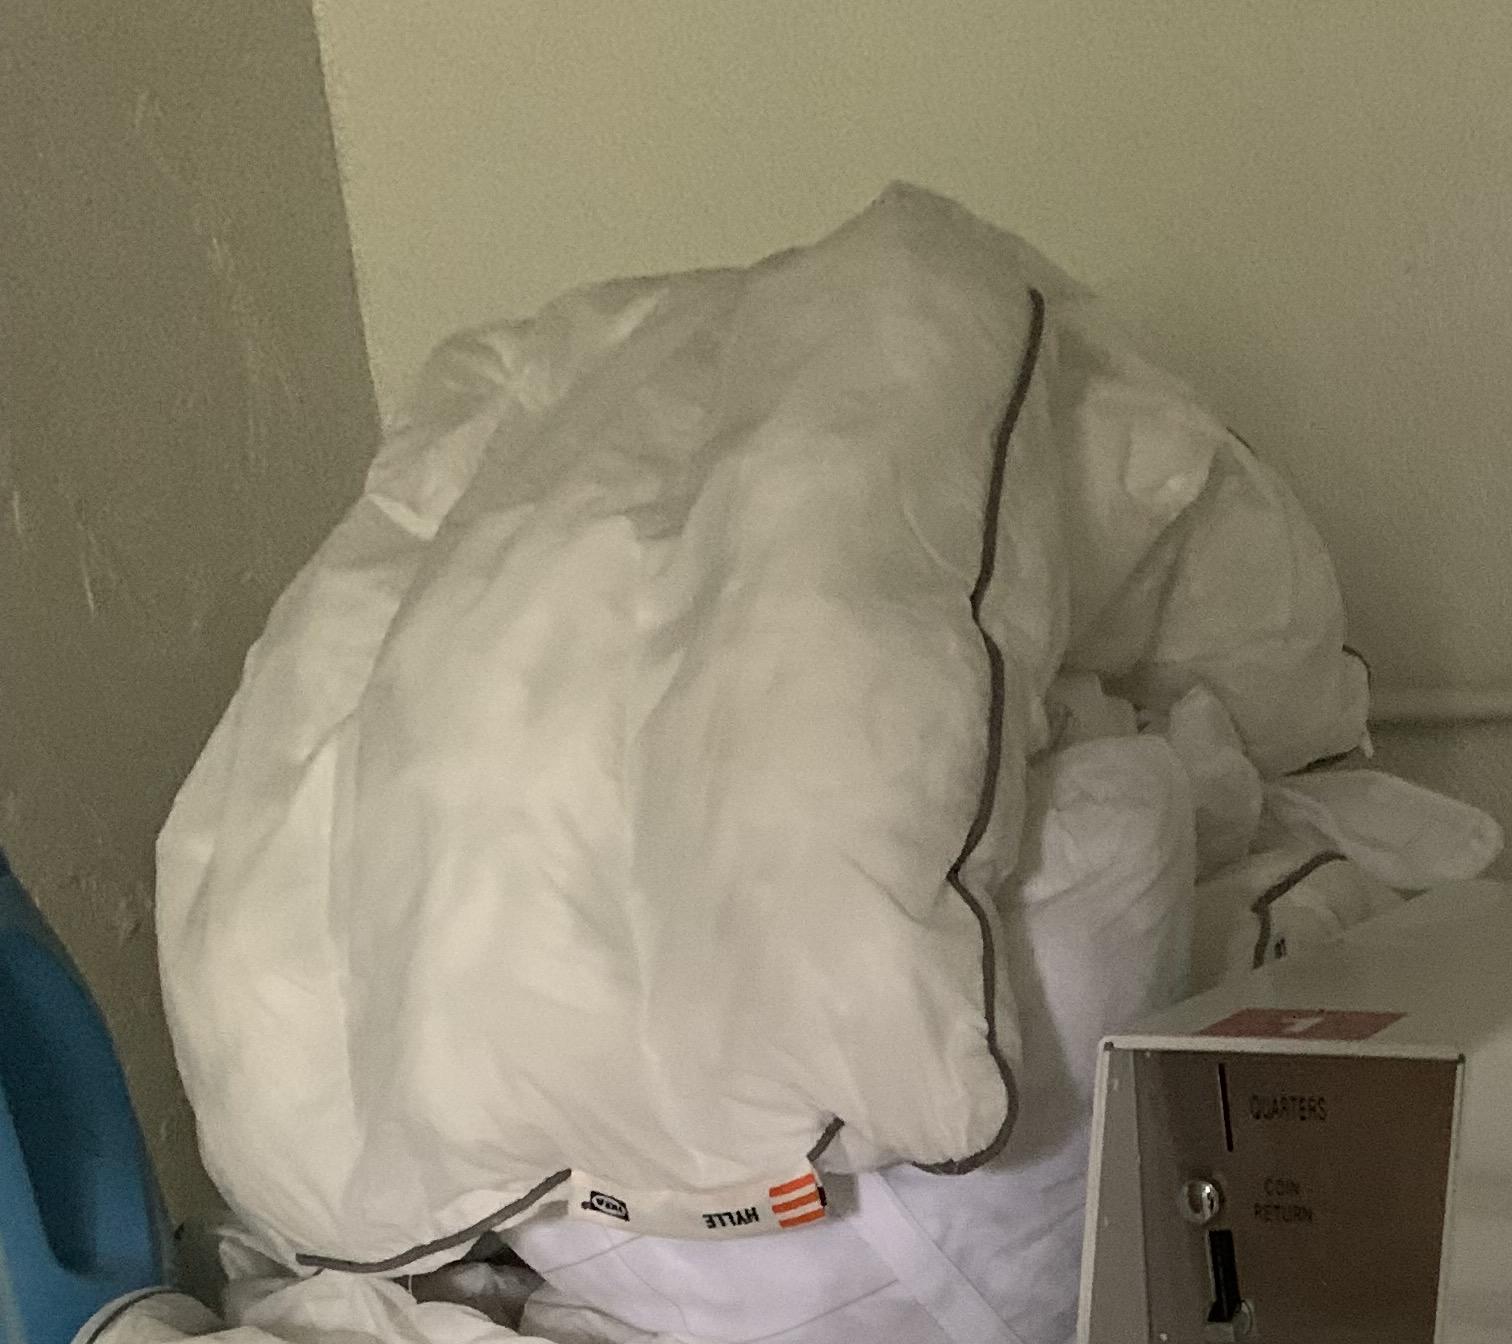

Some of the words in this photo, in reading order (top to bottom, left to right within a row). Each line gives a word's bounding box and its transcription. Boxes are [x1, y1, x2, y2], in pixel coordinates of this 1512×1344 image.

[1250, 1095, 1327, 1121] QUARTERS
[1264, 1178, 1300, 1196] COIN
[702, 1207, 759, 1229] HYLLE
[1254, 1203, 1313, 1223] RETURN
